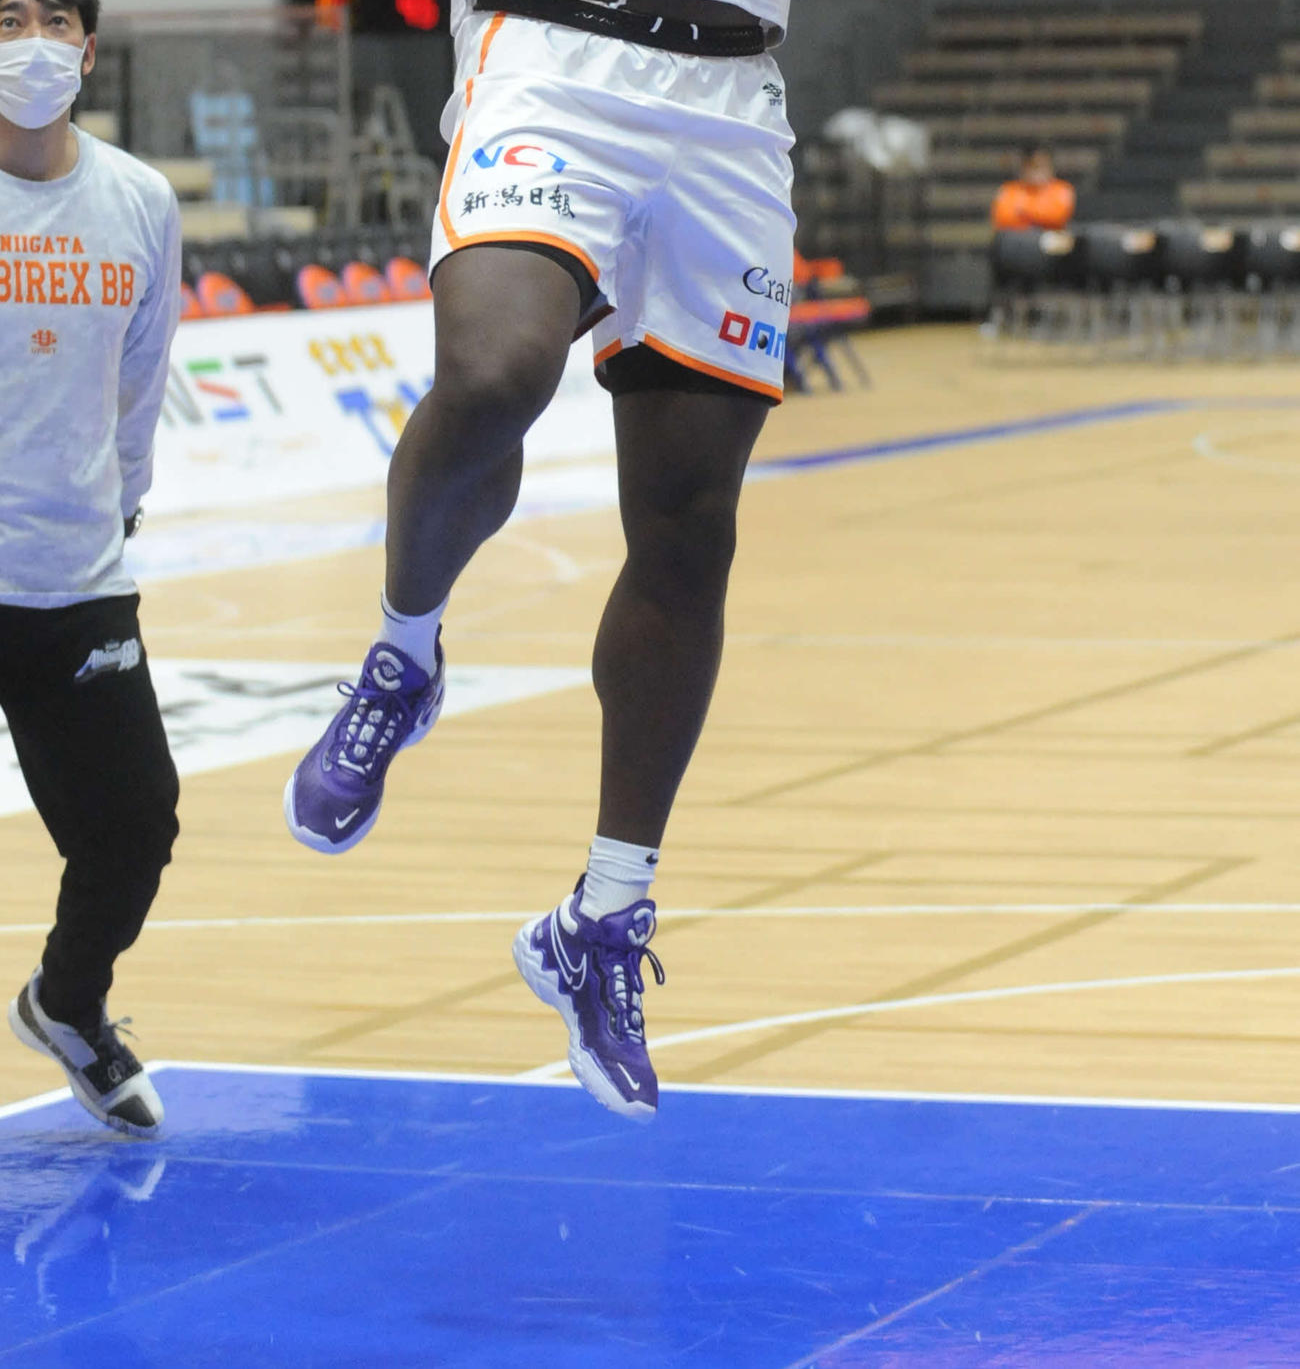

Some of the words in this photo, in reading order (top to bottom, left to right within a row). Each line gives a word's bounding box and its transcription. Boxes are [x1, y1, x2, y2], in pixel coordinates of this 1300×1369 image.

[460, 183, 576, 219] 新潟日報
[0, 234, 84, 254] NIIGATA
[100, 262, 135, 307] BB
